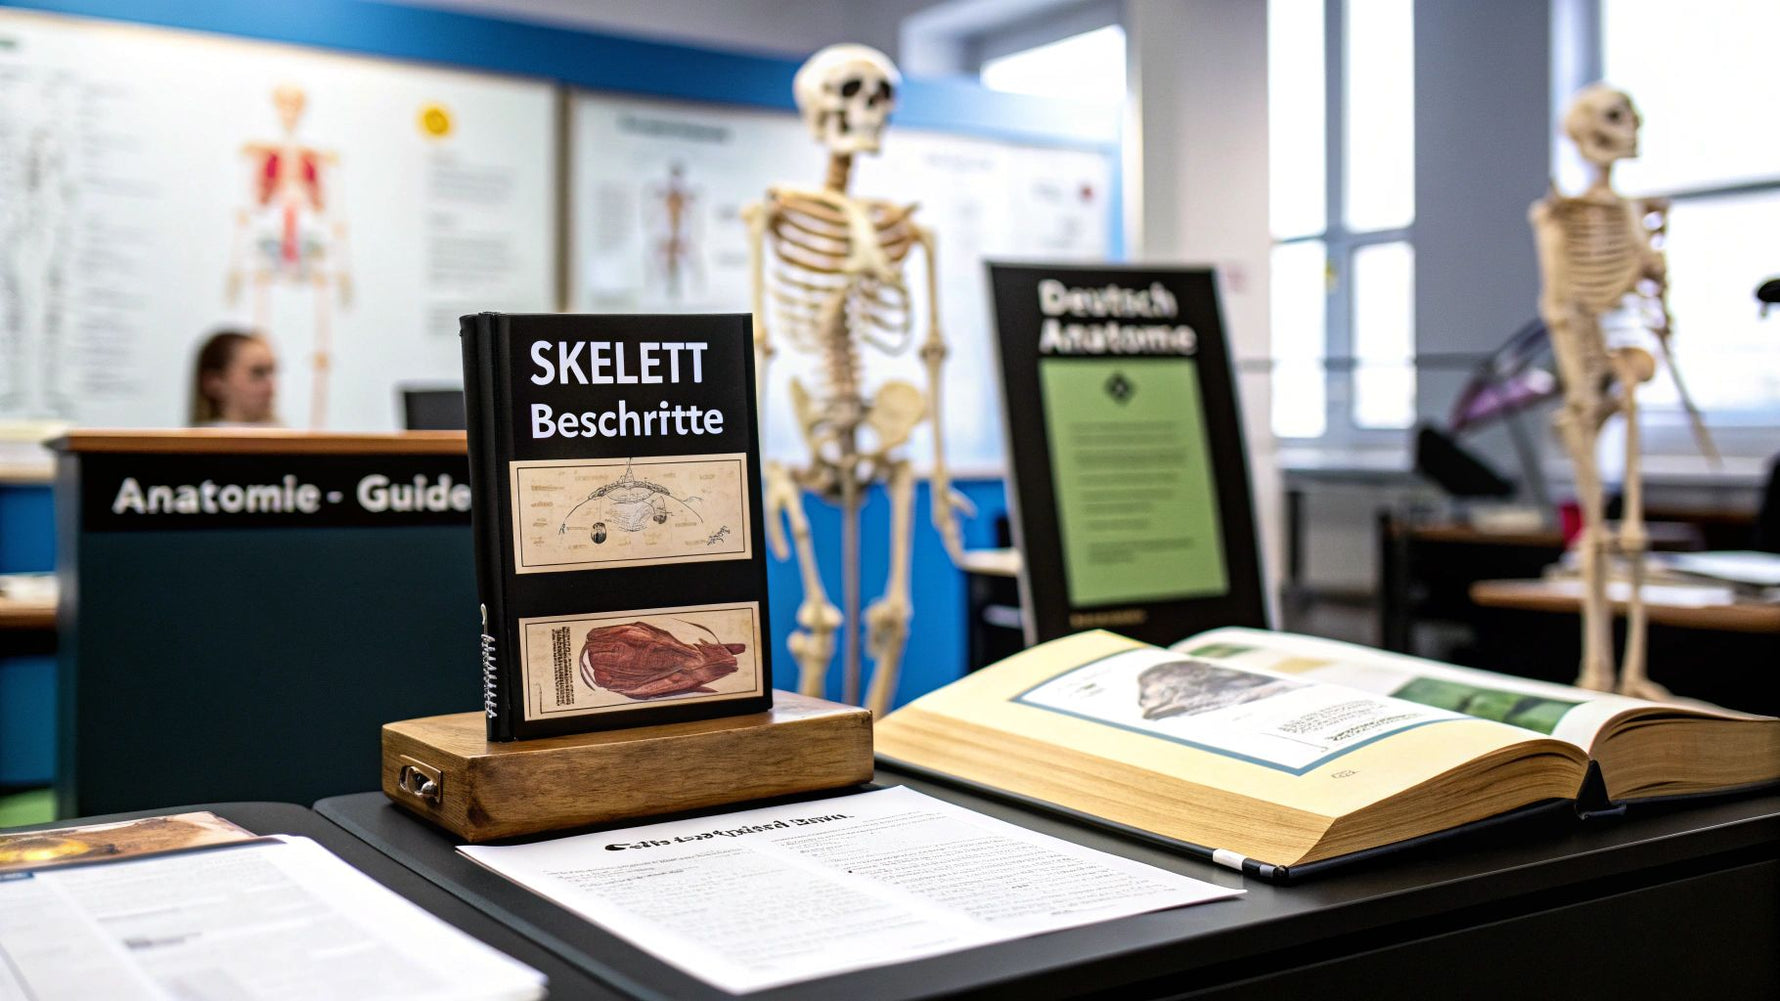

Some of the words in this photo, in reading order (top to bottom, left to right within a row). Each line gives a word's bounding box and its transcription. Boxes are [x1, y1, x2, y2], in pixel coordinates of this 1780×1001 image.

[1038, 279, 1178, 318] Deutsch
[530, 340, 708, 386] SKELETT
[530, 399, 724, 439] Beschritte
[112, 474, 321, 514] Anatomie
[356, 474, 472, 513] Guide
